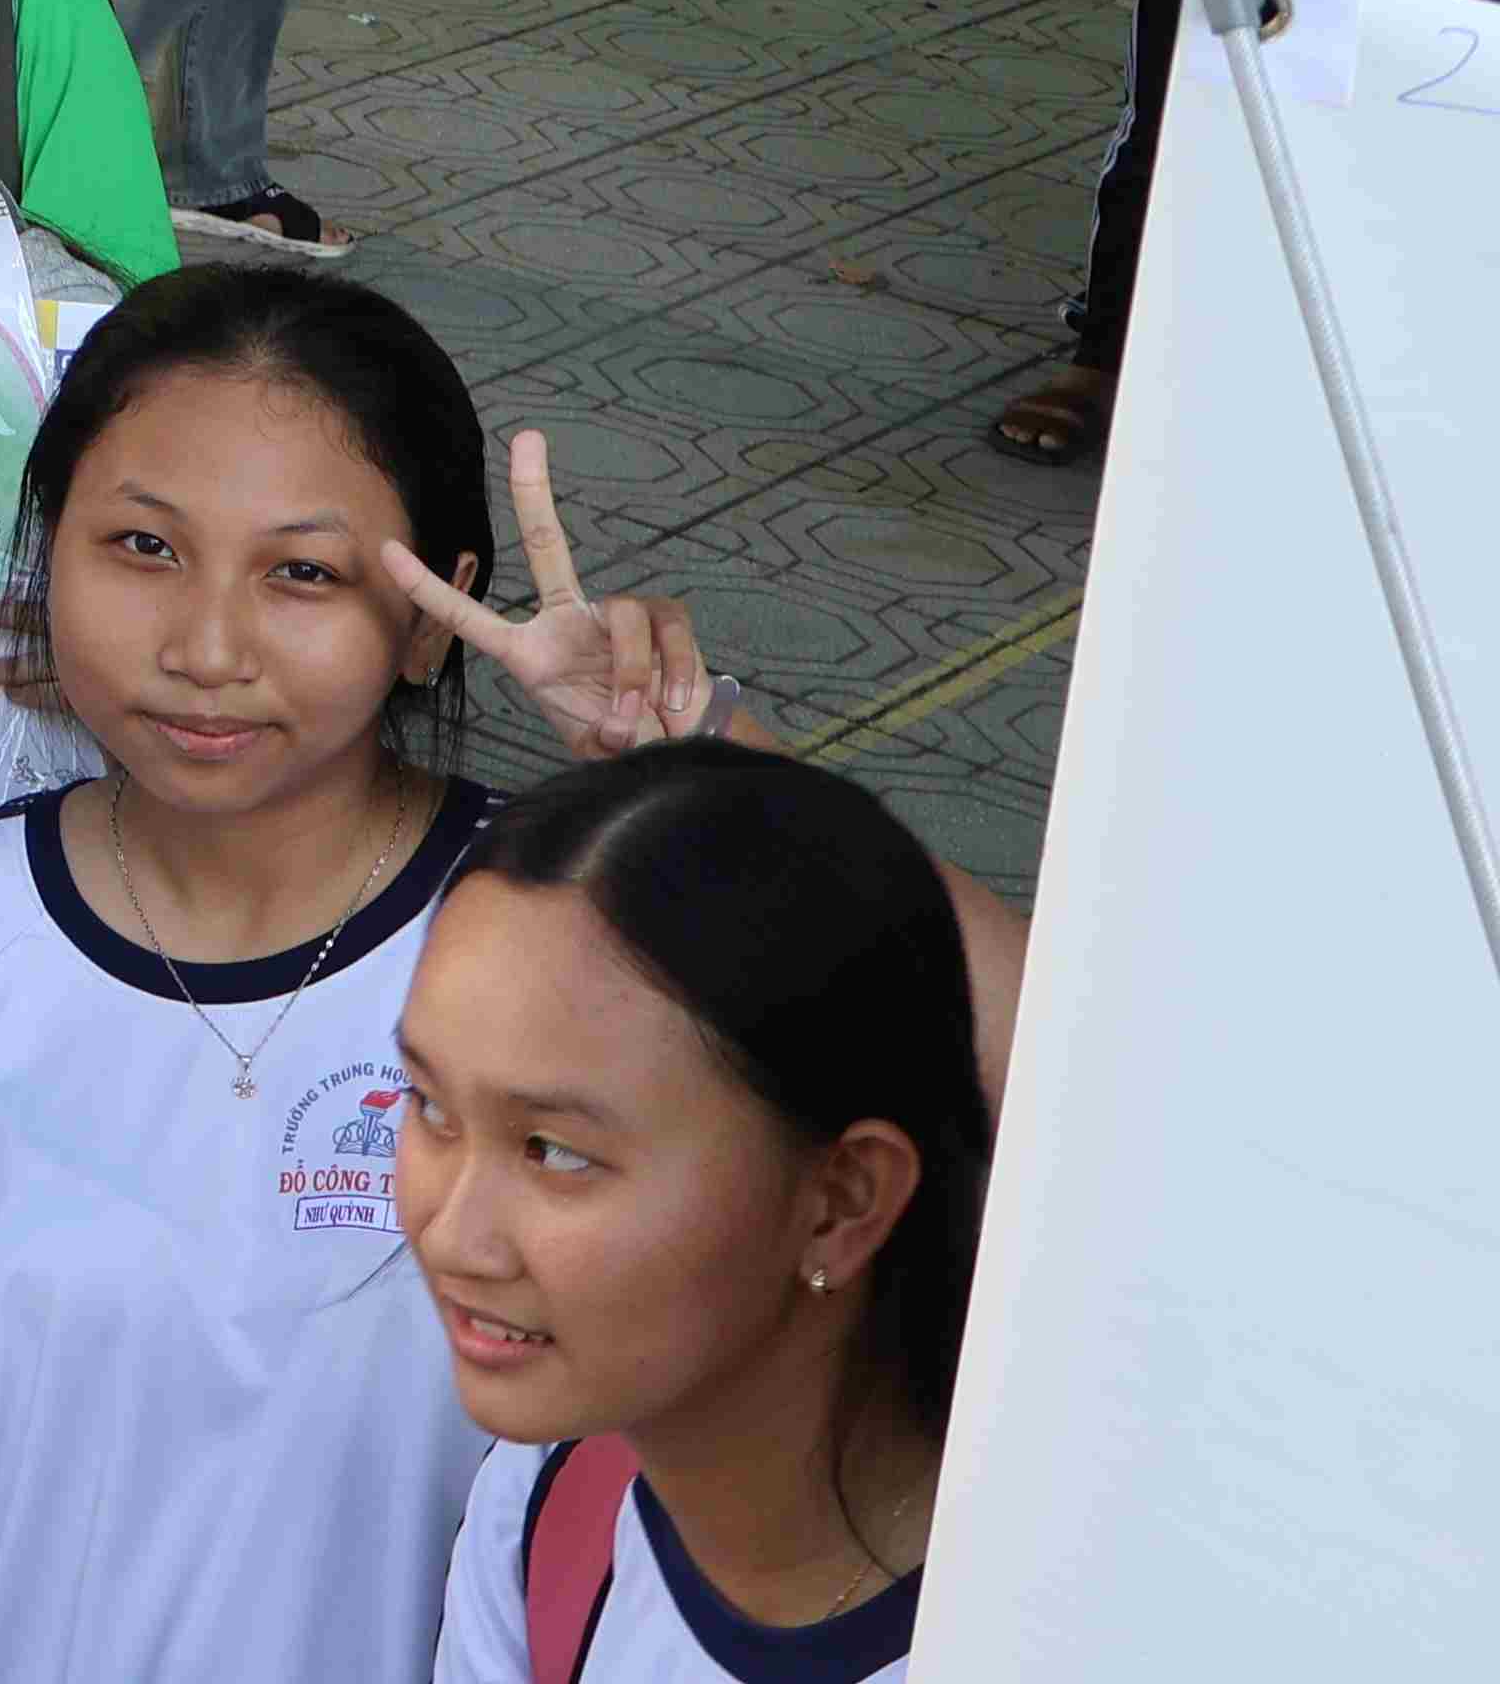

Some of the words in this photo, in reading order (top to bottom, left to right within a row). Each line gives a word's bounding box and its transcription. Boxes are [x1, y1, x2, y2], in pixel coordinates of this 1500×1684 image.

[281, 1088, 320, 1156] TRƯỜNG
[319, 1061, 375, 1093] TRUNG
[312, 1164, 372, 1195] CÔNG
[303, 1201, 327, 1224] NHƯ
[328, 1203, 375, 1227] QUỲNH
